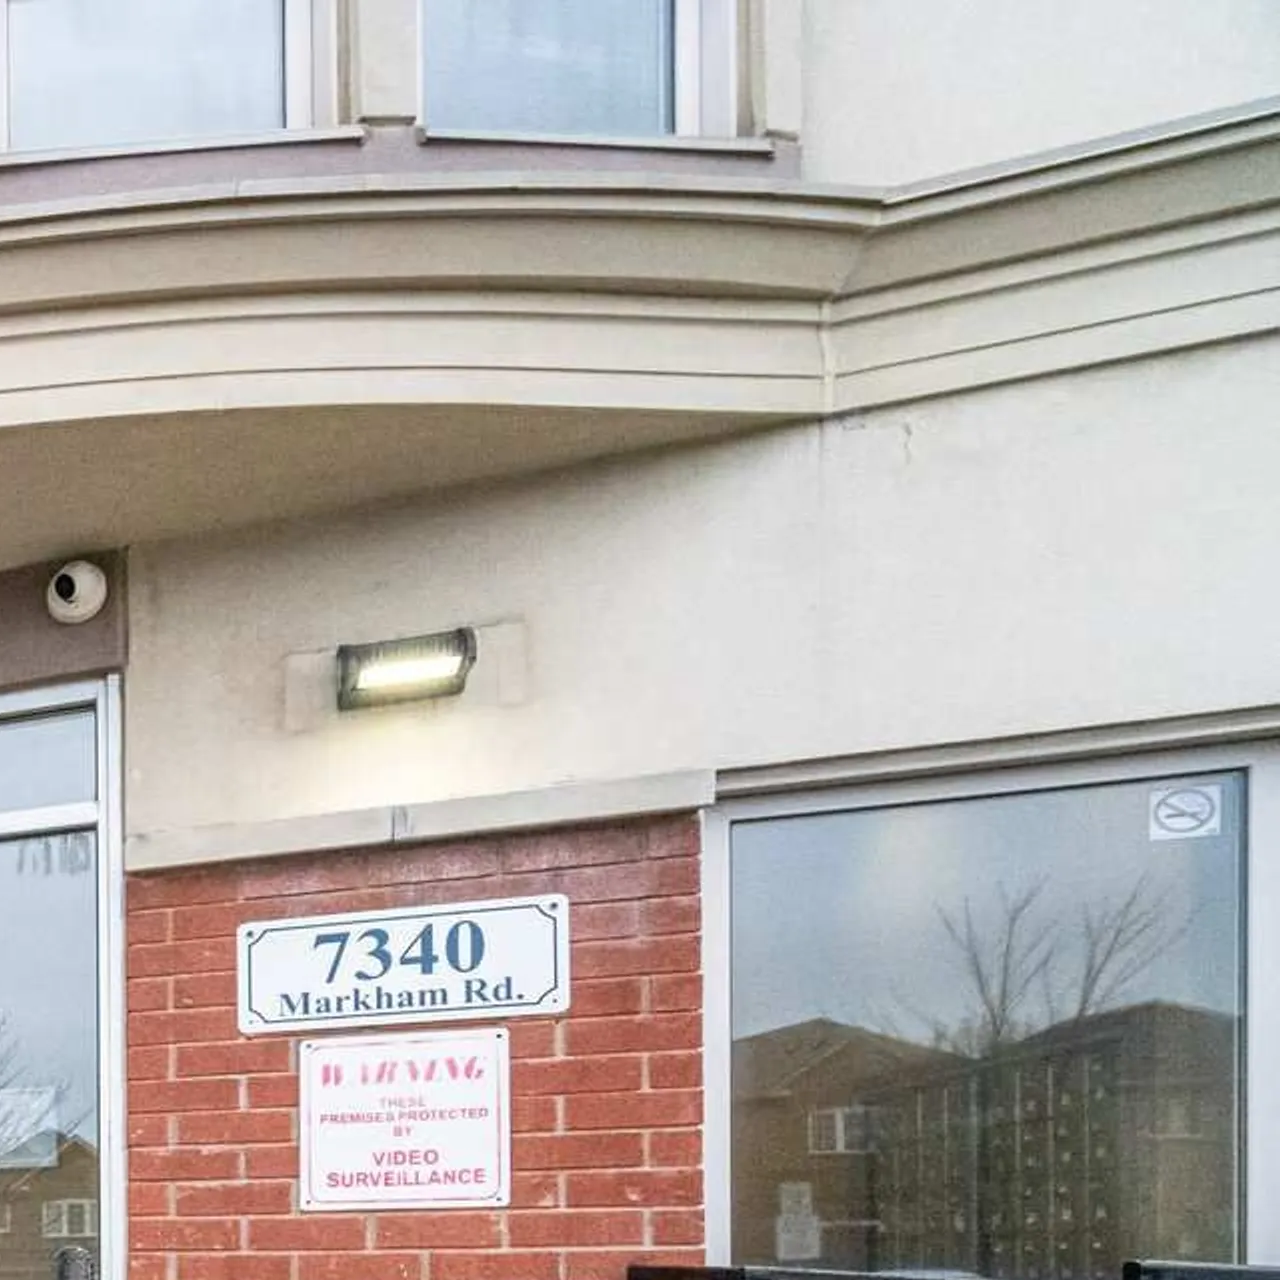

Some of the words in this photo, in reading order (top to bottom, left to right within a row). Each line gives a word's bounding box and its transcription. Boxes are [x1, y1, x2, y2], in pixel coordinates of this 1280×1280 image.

[313, 920, 485, 984] 7340
[278, 986, 449, 1018] Markham
[464, 976, 525, 1004] Rd.
[397, 1108, 489, 1122] PROTECTED
[392, 1125, 414, 1138] BY
[372, 1149, 440, 1166] VIDEO
[326, 1167, 487, 1188] SURVEILLANCE
